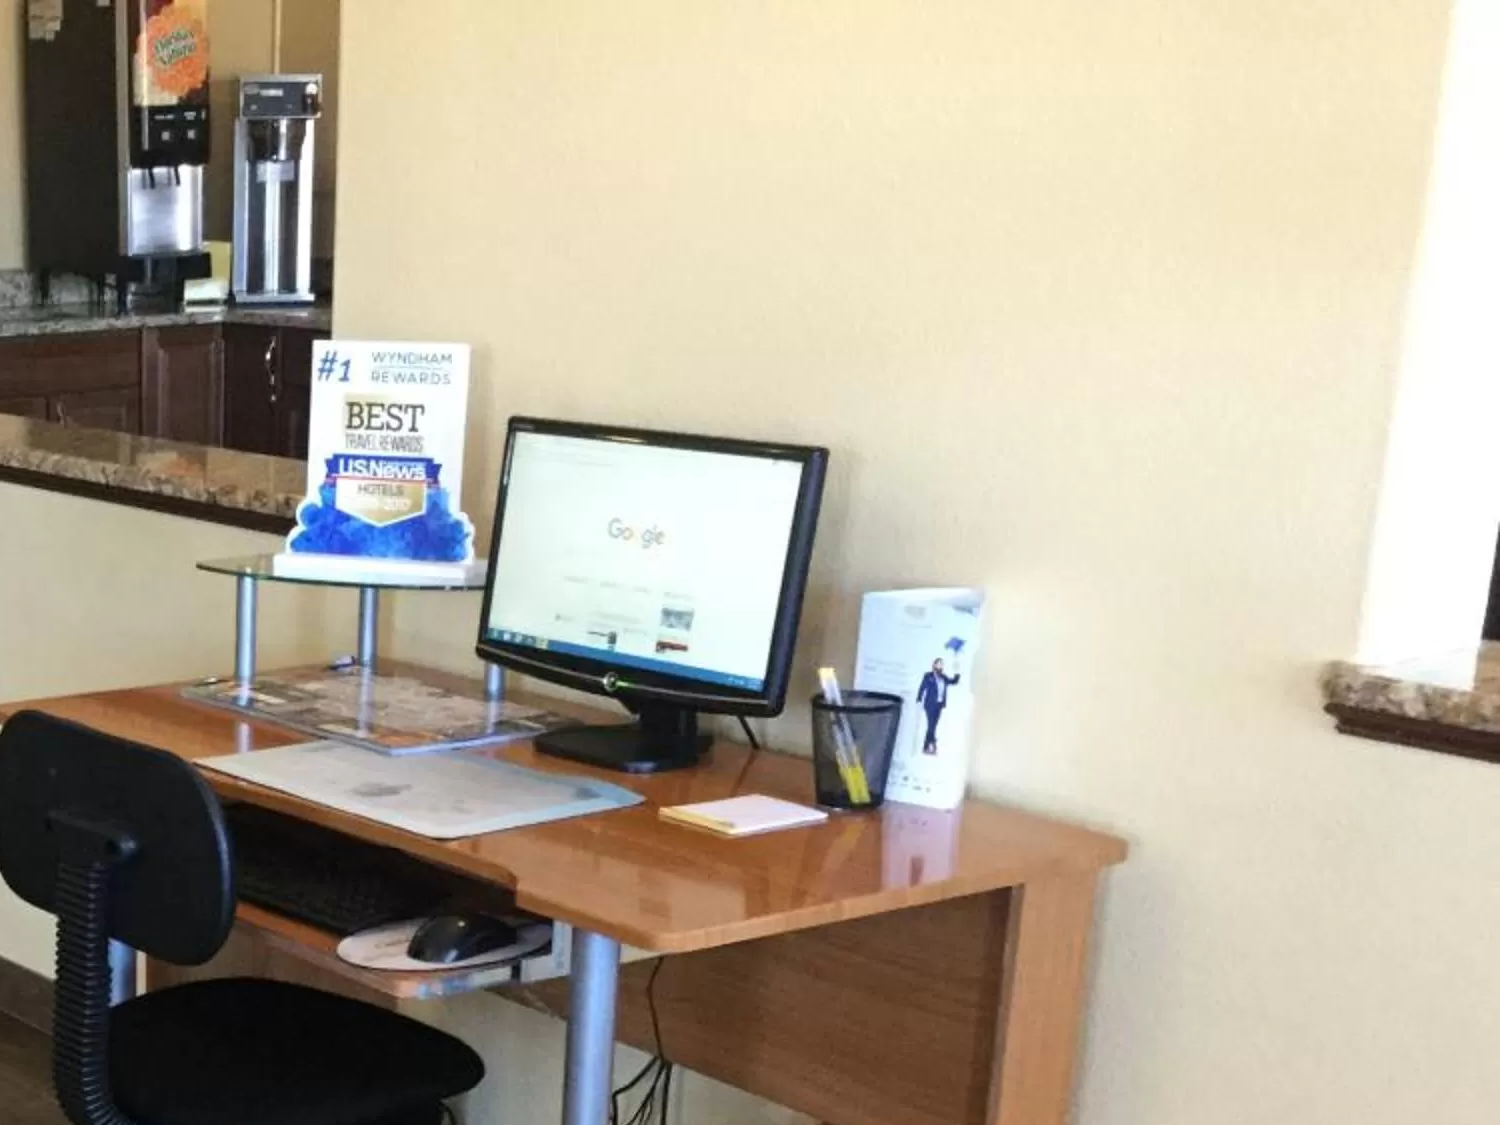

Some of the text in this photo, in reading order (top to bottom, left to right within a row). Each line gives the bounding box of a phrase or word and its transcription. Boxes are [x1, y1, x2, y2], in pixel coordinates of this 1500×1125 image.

[317, 349, 351, 382] #1
[371, 351, 453, 365] WYNDHAM
[371, 370, 452, 385] REWARDS
[345, 401, 425, 433] BEST
[357, 482, 405, 496] HOTELS
